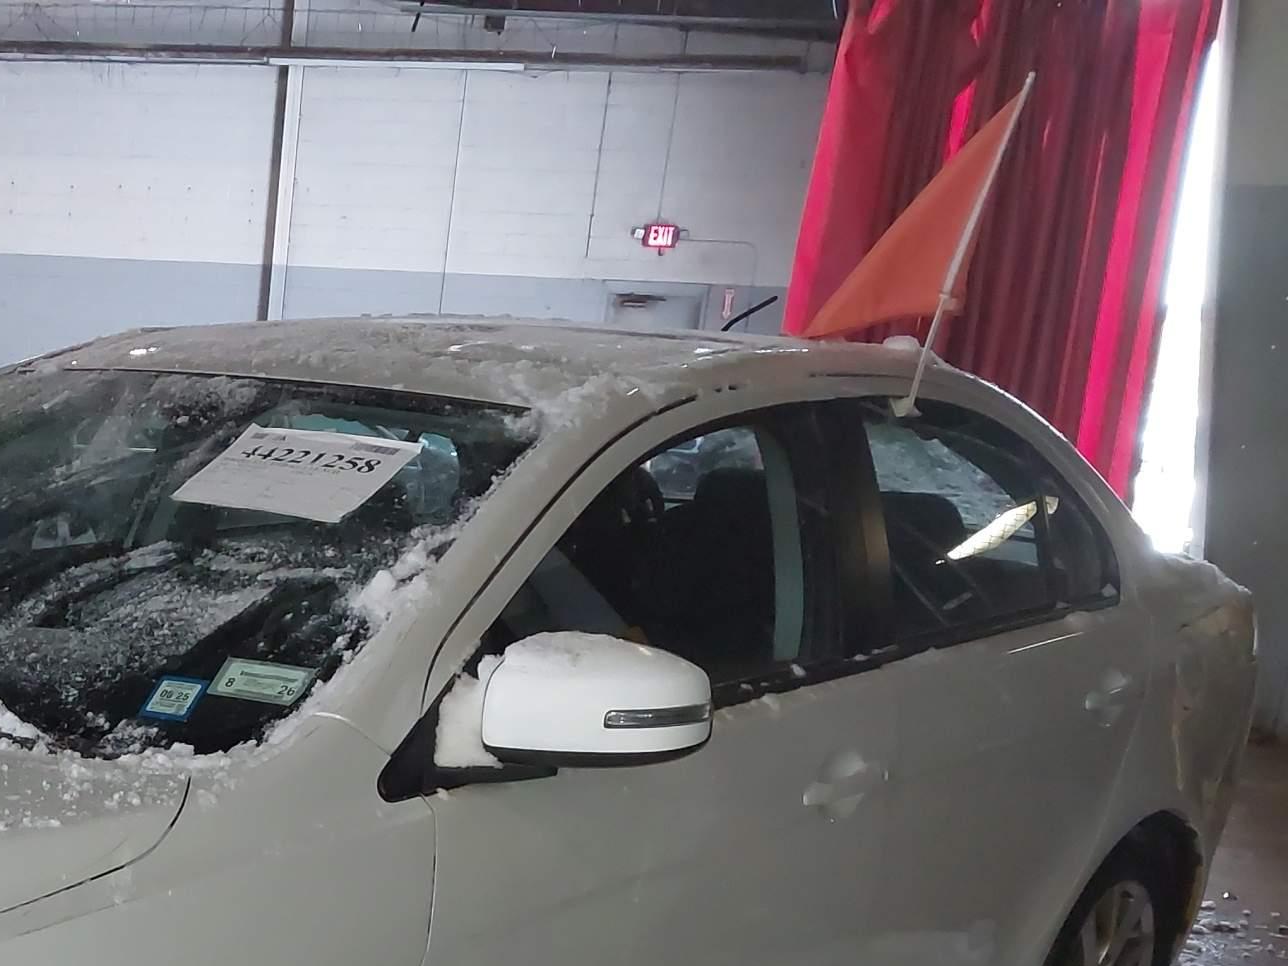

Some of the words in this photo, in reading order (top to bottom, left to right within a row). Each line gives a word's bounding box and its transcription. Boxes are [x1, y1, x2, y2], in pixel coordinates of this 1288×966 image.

[648, 225, 675, 246] EXIT
[240, 444, 382, 475] 44221258
[176, 692, 191, 701] 25
[224, 677, 236, 688] 8
[277, 685, 296, 697] 26
